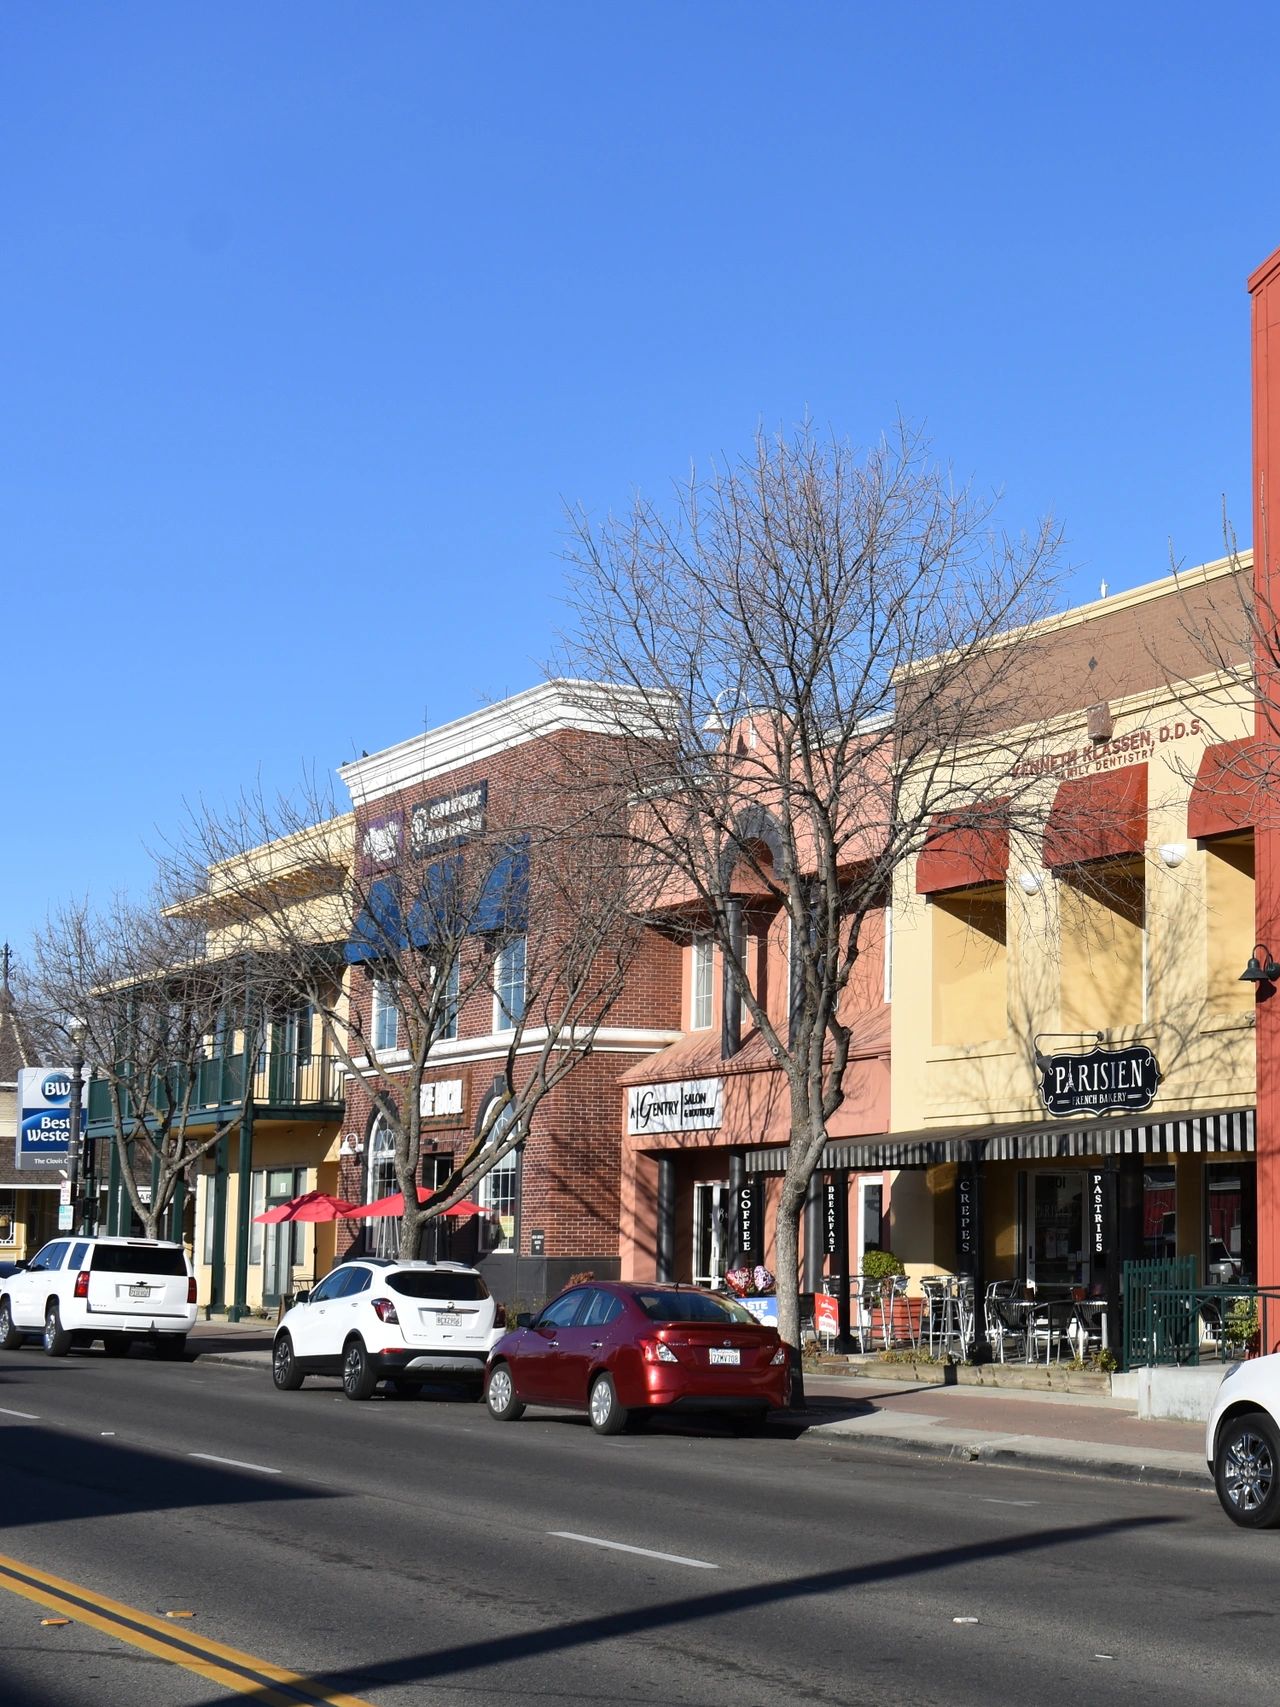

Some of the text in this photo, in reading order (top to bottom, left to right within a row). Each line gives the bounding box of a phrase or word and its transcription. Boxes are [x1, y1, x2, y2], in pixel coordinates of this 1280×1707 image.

[1159, 719, 1204, 743] D.D.S.
[1055, 749, 1155, 781] AMILY DENTISTRY
[1055, 1059, 1143, 1094] PARISIEN
[44, 1082, 70, 1096] BW
[684, 1093, 706, 1105] SALON
[1072, 1092, 1127, 1106] FRENCH BAKERY
[689, 1107, 715, 1118] BOUTIQUE
[41, 1117, 70, 1129] Best
[27, 1129, 85, 1141] Weste
[740, 1189, 751, 1251] COFFEE
[827, 1186, 836, 1252] BREAKFAST
[960, 1181, 971, 1252] CREPES
[1093, 1175, 1103, 1252] PASTRIES
[739, 1300, 769, 1310] ASTE
